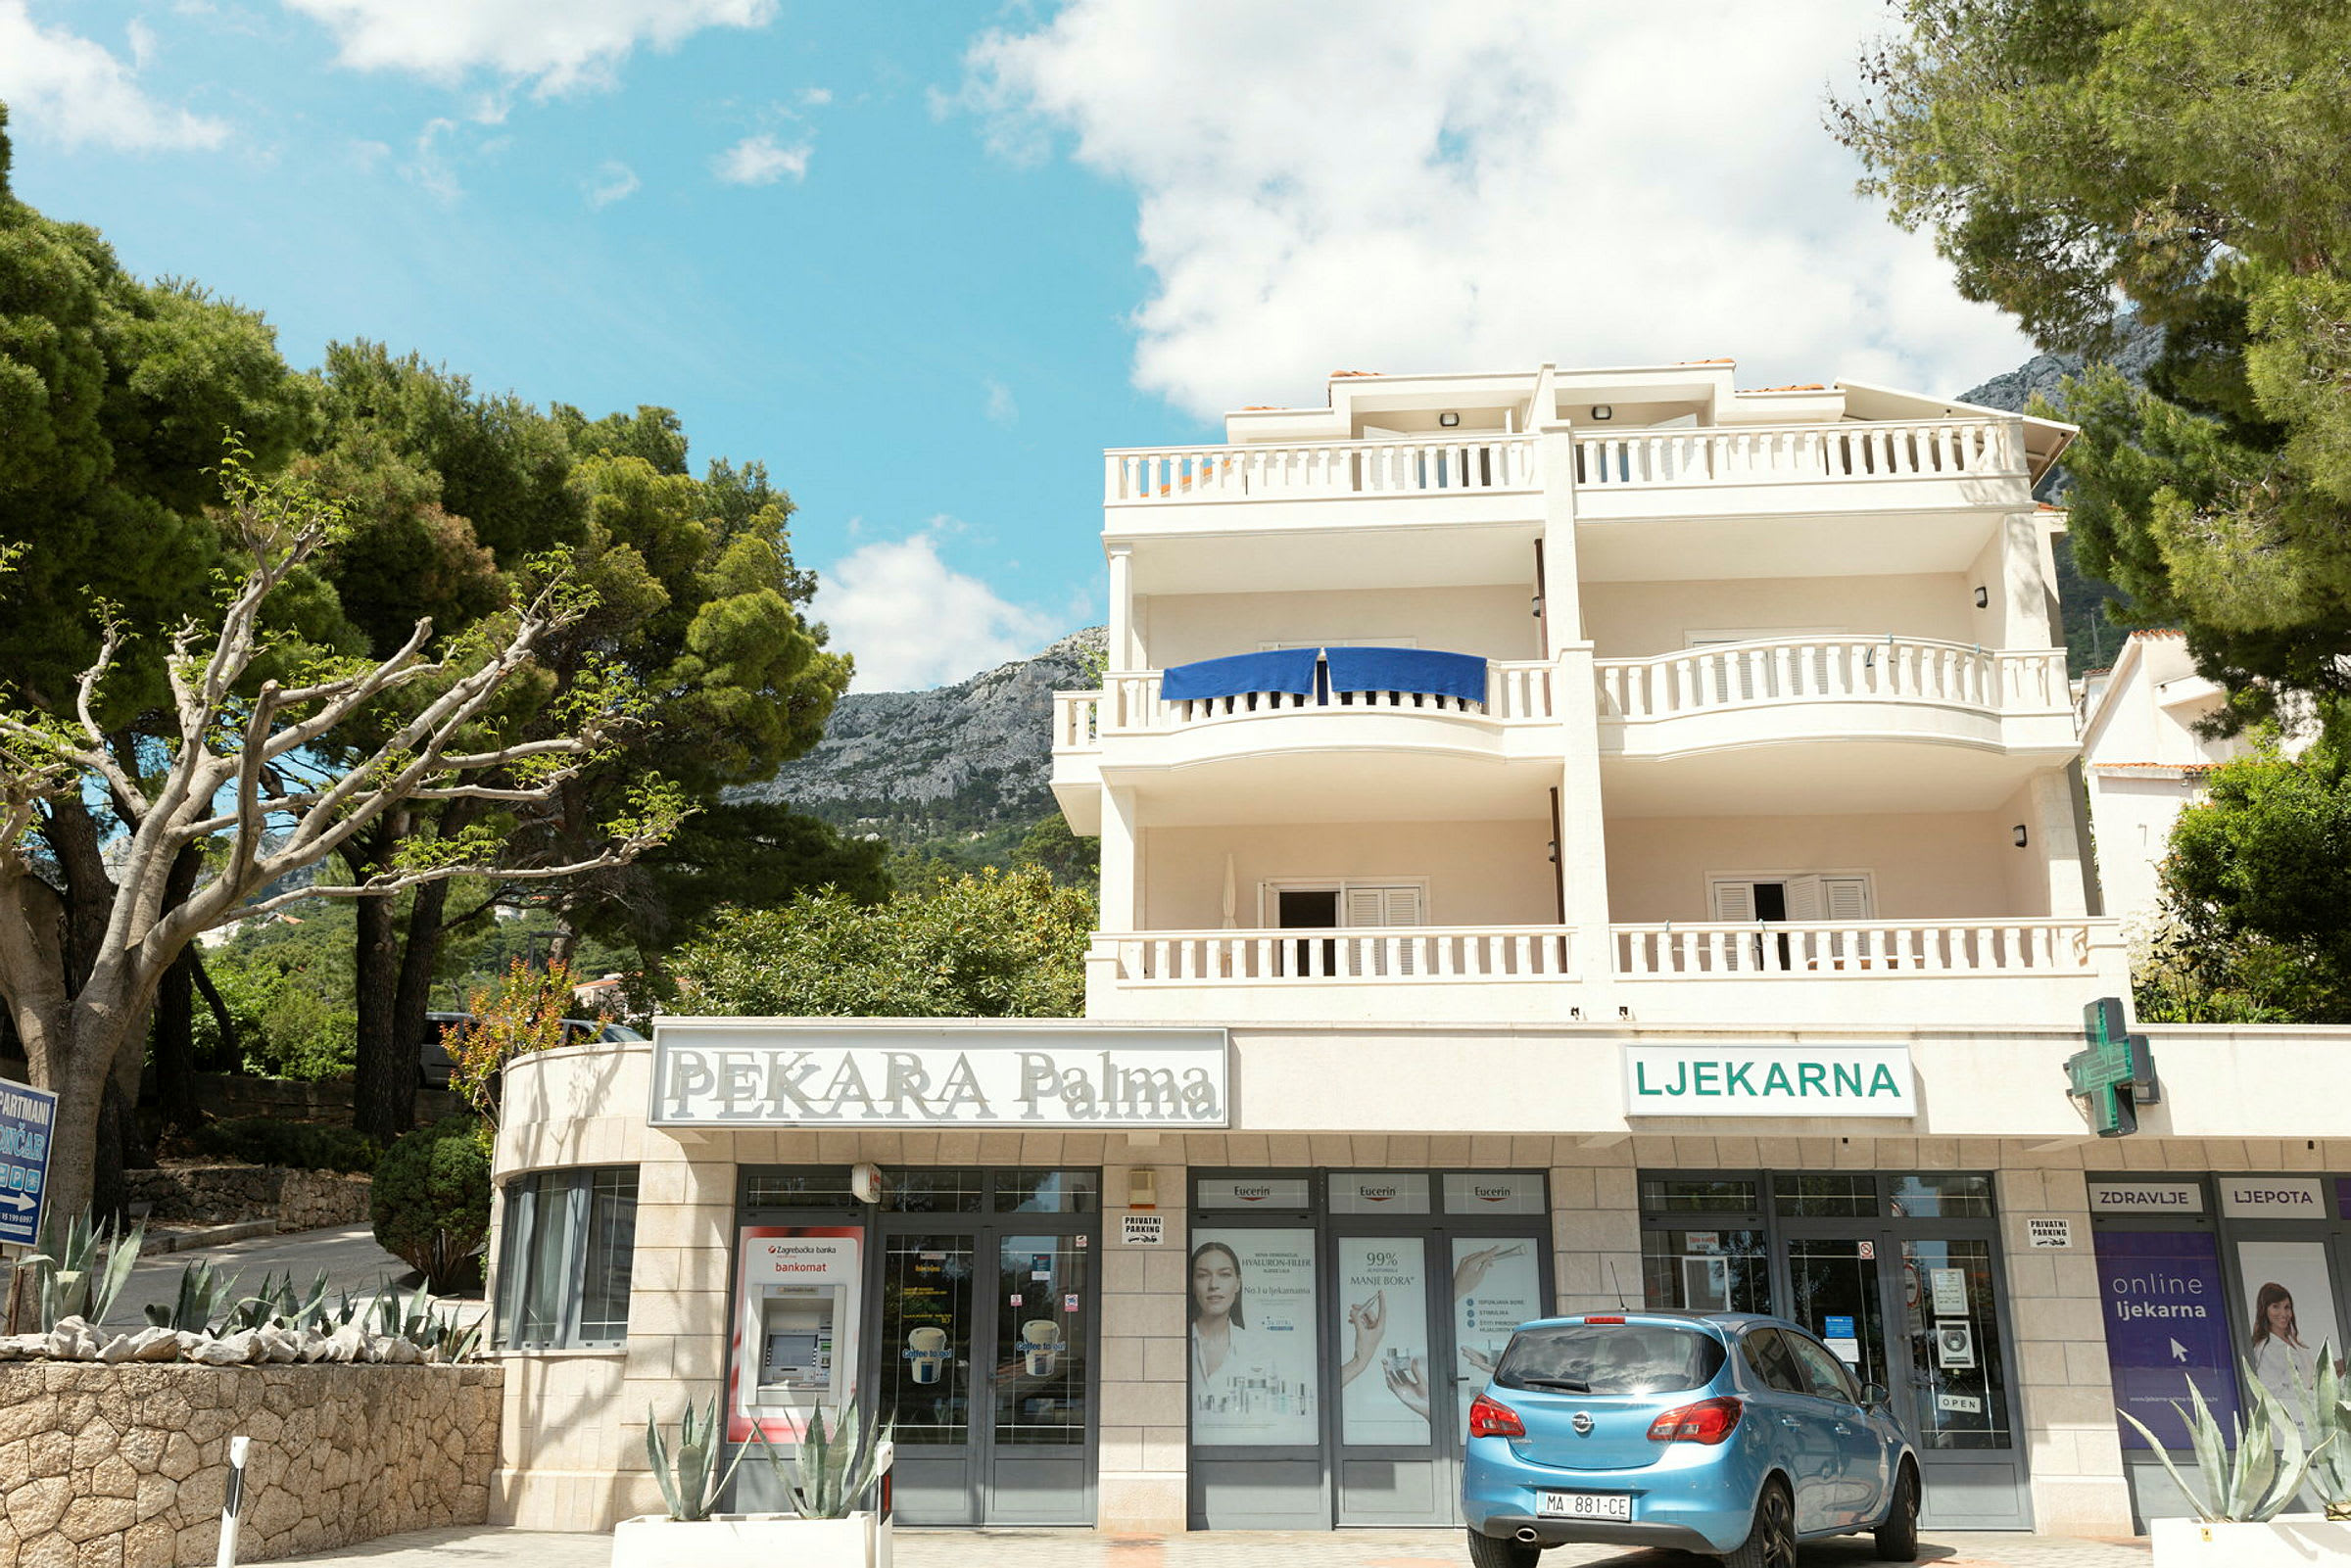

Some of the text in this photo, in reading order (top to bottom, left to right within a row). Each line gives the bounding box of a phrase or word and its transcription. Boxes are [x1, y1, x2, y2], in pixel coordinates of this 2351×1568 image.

[666, 1049, 1219, 1115] PEKARA Palma
[1636, 1061, 1901, 1098] LJEKARNA
[1234, 1186, 1271, 1196] Eucerin
[1360, 1185, 1396, 1196] Eucerin
[1474, 1186, 1511, 1197] Eucerin
[2099, 1191, 2189, 1205] ZDRAVLJE
[2233, 1190, 2314, 1205] LJEPOTA
[1125, 1216, 1162, 1225] PRIVATNI
[2032, 1228, 2067, 1237] PARKING
[816, 1245, 837, 1254] banka
[1366, 1252, 1398, 1267] 99%
[775, 1262, 827, 1272] bankomat
[1350, 1276, 1381, 1286] MANJE
[2113, 1272, 2203, 1295] online
[2117, 1300, 2207, 1321] ljekarna
[1943, 1398, 1976, 1408] OPEN
[1547, 1495, 1627, 1516] MA 881-CE
